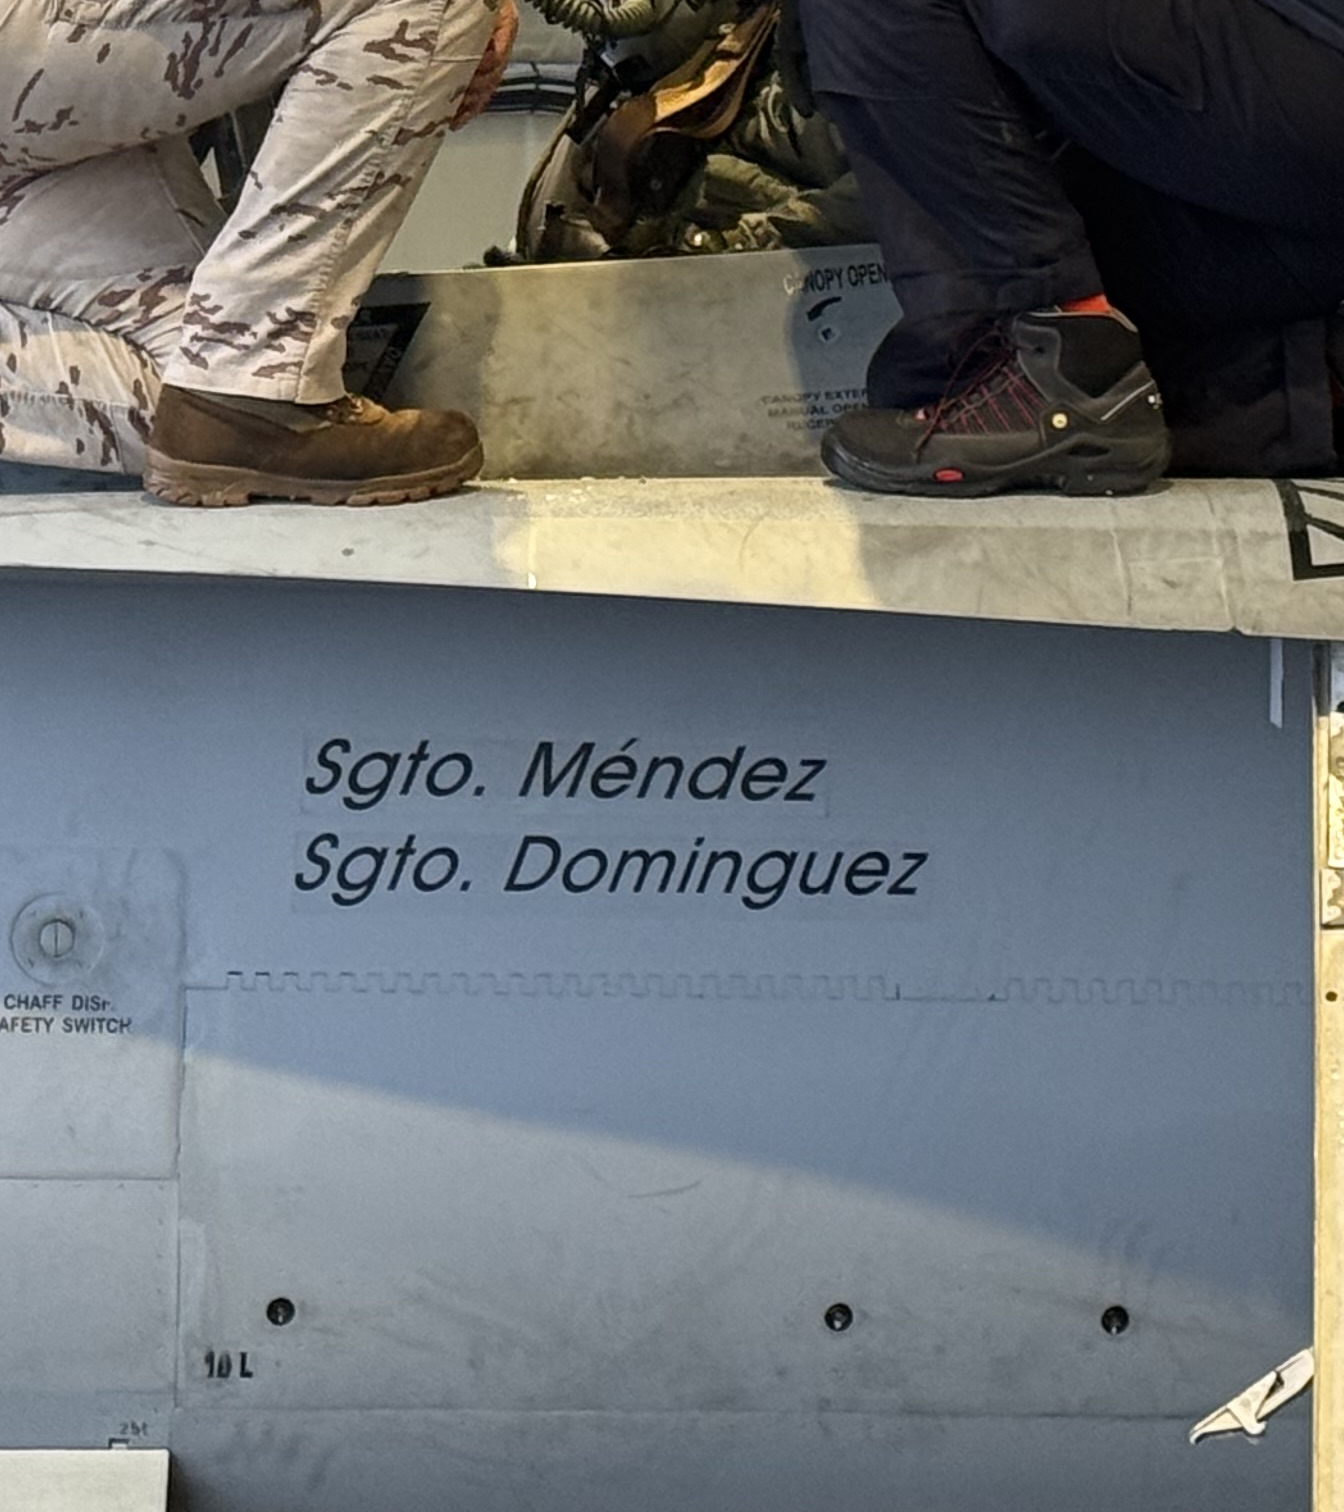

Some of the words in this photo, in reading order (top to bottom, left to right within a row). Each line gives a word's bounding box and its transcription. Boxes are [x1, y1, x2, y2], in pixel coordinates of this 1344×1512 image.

[304, 737, 485, 811] Sgto.
[518, 737, 827, 803] Méndez
[293, 831, 473, 908] Sgto.
[503, 834, 930, 911] Dominguez
[3, 993, 64, 1011] CHAFF
[61, 1016, 132, 1034] SWITCH
